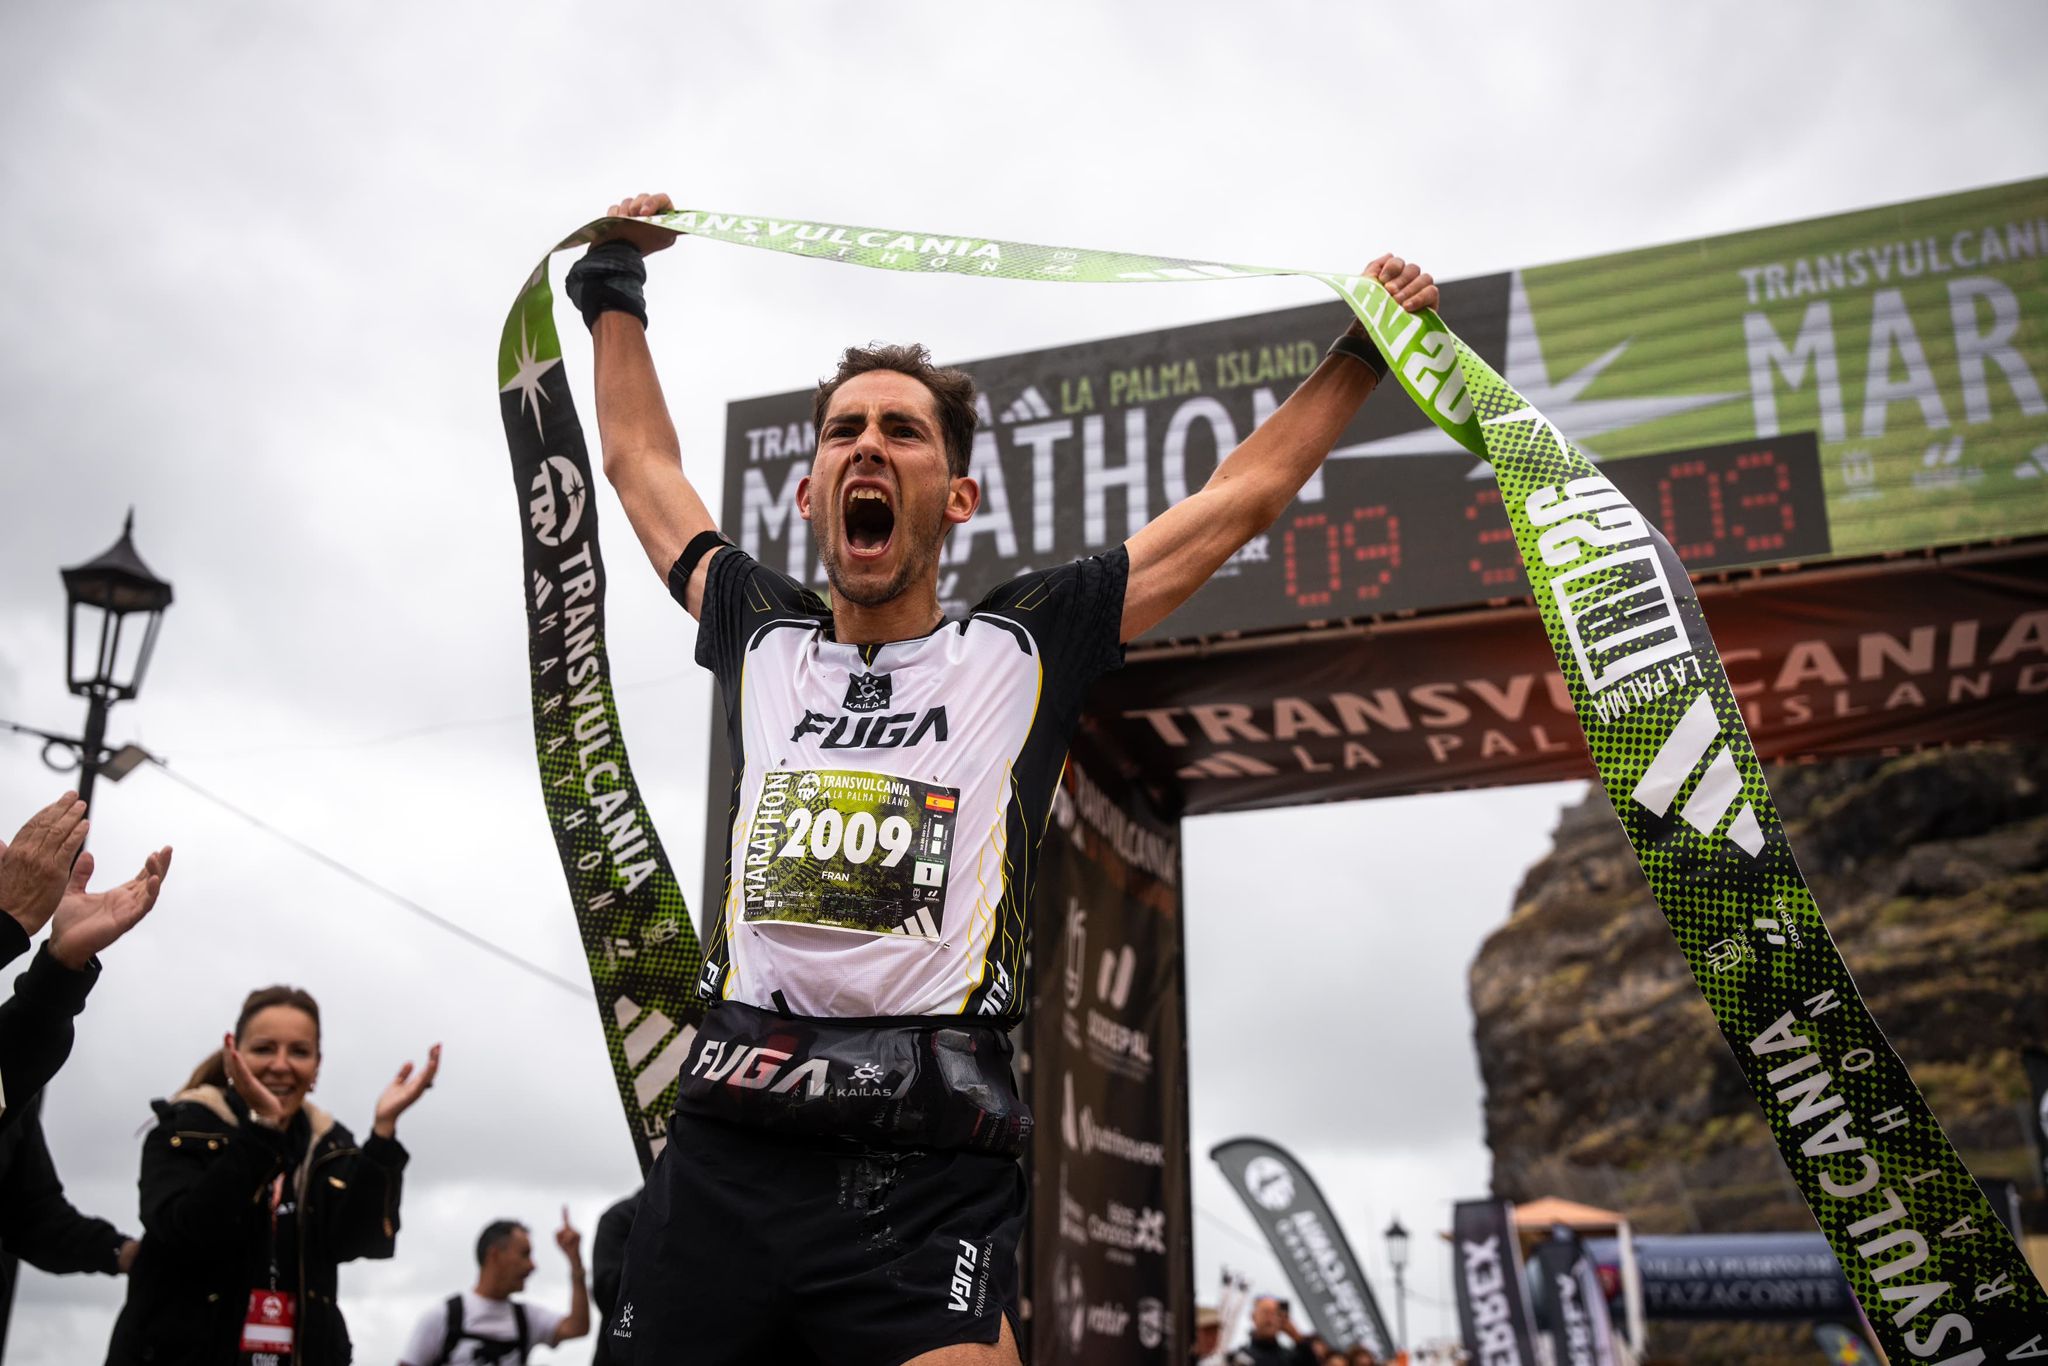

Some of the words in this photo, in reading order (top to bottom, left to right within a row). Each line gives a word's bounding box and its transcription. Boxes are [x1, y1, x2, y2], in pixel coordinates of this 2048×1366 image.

[650, 212, 1001, 259] ANSVULCANIA
[1061, 377, 1094, 414] LA
[1110, 359, 1201, 406] PALMA
[1217, 341, 1318, 388] ISLAND
[1743, 276, 2048, 443] MAR
[1284, 504, 1401, 606] 09
[1593, 668, 1670, 724] PALMA
[1668, 654, 1705, 687] LA
[559, 541, 658, 895] TRANSVULCANIA
[790, 705, 948, 750] FUGA
[538, 611, 616, 912] MARATHON
[1292, 741, 1382, 773] LA
[823, 776, 910, 797] TRANSVULCANIA
[833, 790, 842, 799] LA
[847, 792, 874, 802] PALMA
[878, 795, 910, 808] ISLAND
[746, 773, 790, 903] MARATHON
[777, 808, 912, 868] 2009
[821, 871, 849, 881] FRAN
[926, 868, 932, 880] 1
[1775, 894, 1806, 949] SODEPAL
[690, 1039, 830, 1097] FUGA
[837, 1088, 892, 1097] KAILAS
[947, 1239, 978, 1312] FUGA
[982, 1242, 993, 1269] TRAIL
[974, 1270, 989, 1318] RUNNING
